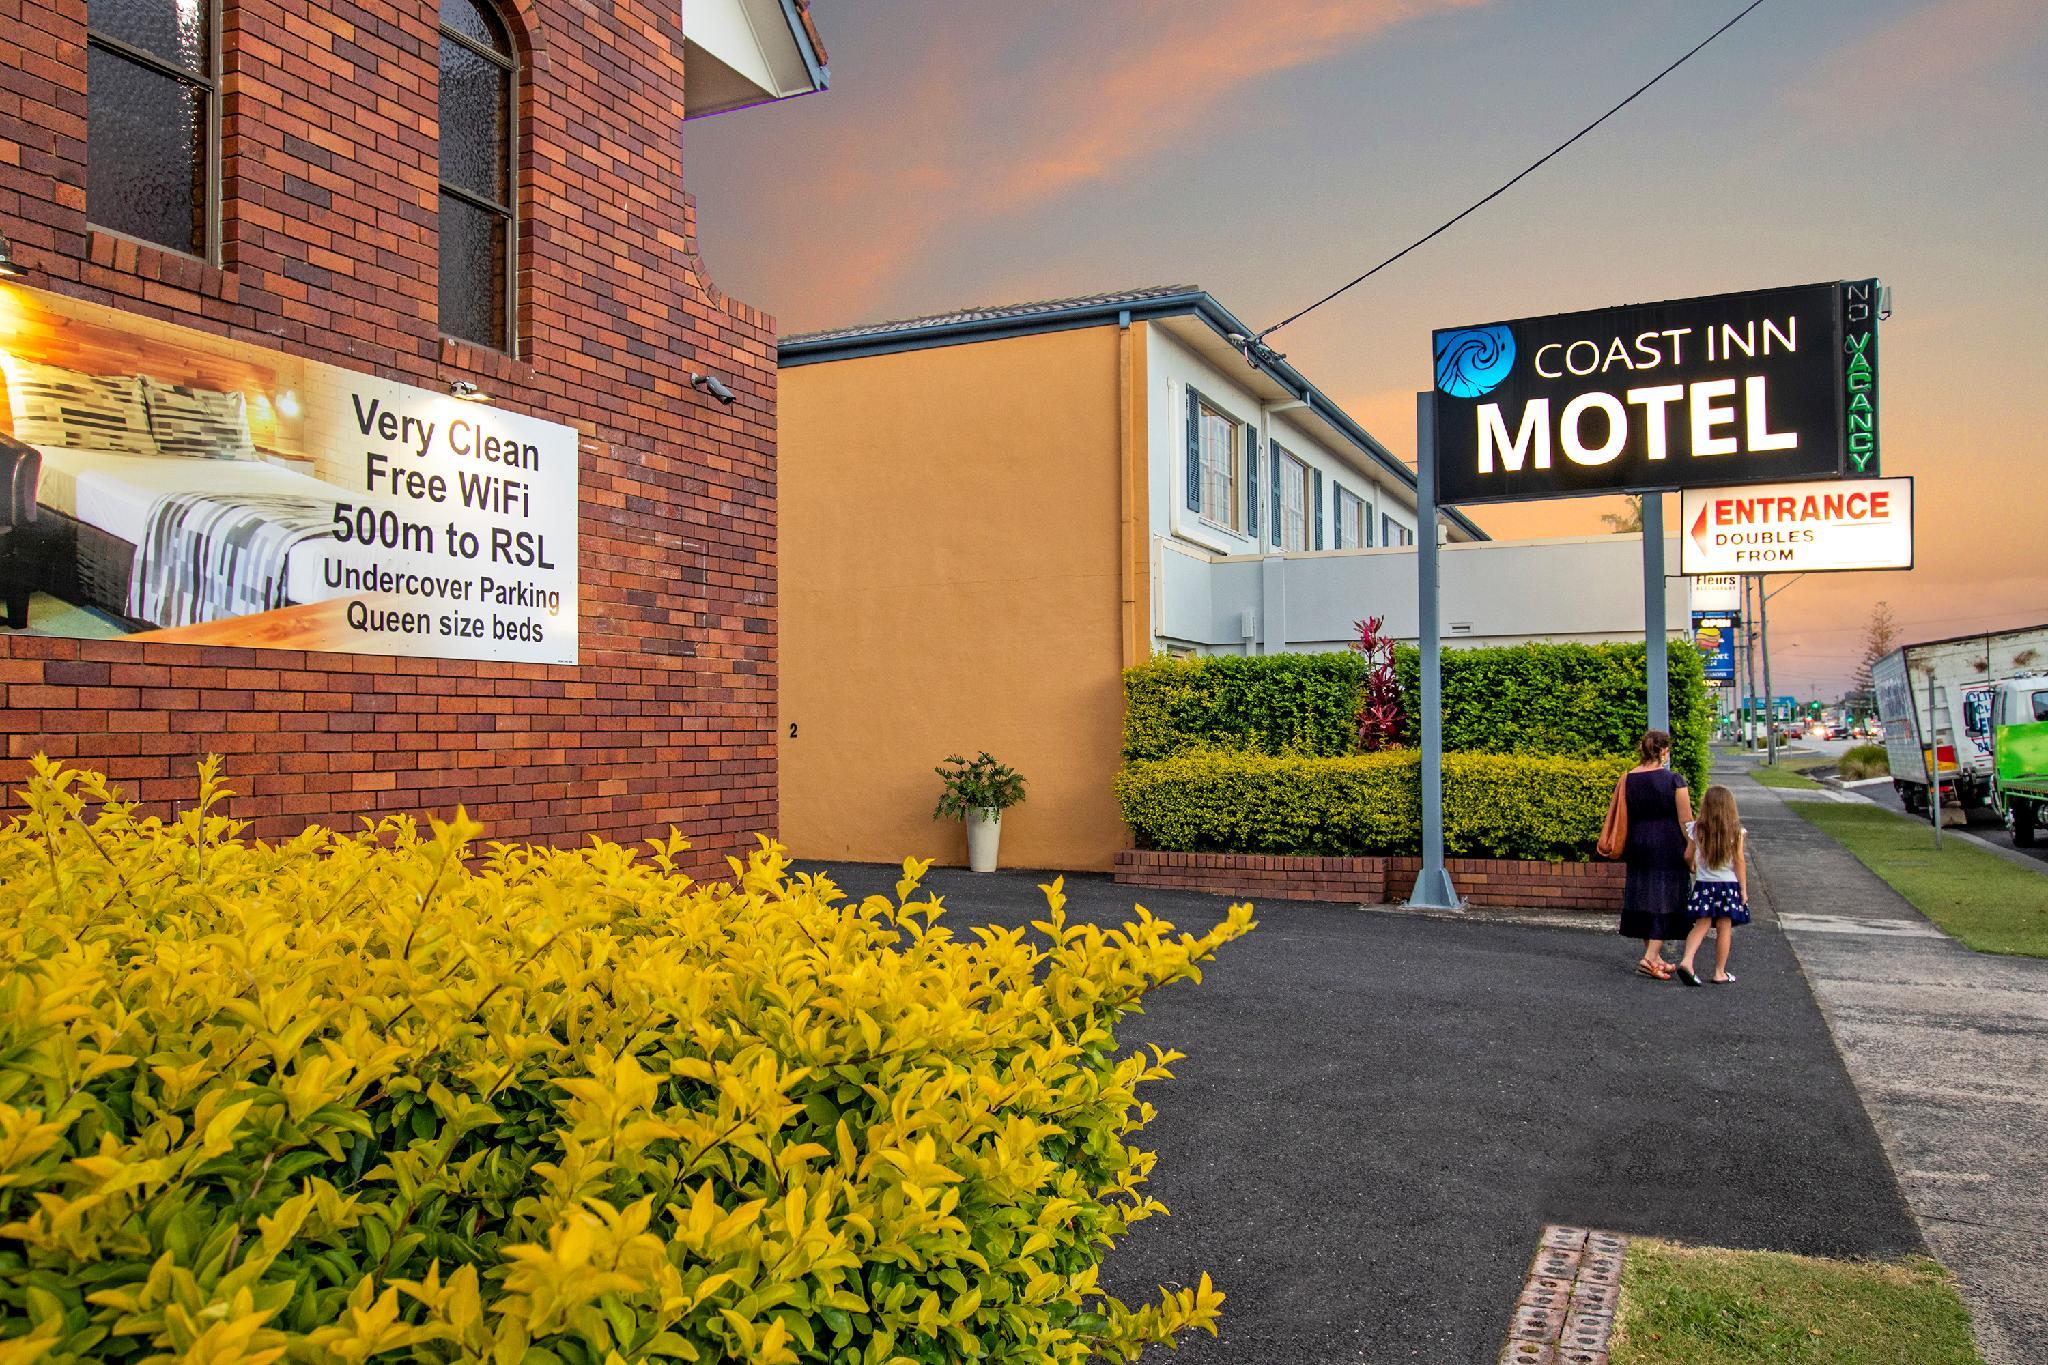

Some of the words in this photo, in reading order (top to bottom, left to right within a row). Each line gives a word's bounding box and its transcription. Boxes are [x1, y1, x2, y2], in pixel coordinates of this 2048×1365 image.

[1535, 327, 1692, 379] COAST
[1708, 316, 1797, 361] INN
[1477, 376, 1798, 474] MOTEL
[1846, 332, 1873, 472] VACANCY
[352, 394, 435, 457] Very
[449, 419, 539, 471] Clean
[367, 452, 446, 503] Free
[459, 471, 529, 517] WiFi
[1715, 491, 1889, 526] ENTRANCE
[332, 502, 433, 553] 500m
[446, 522, 479, 559] to
[492, 527, 554, 569] RSL
[1715, 530, 1815, 546] DOUBLES
[1736, 549, 1794, 562] FROM
[324, 558, 472, 600] Undercover
[480, 577, 559, 616] Parking
[347, 601, 430, 633] Queen
[439, 610, 484, 638] size
[493, 614, 543, 643] beds
[790, 723, 798, 738] 2
